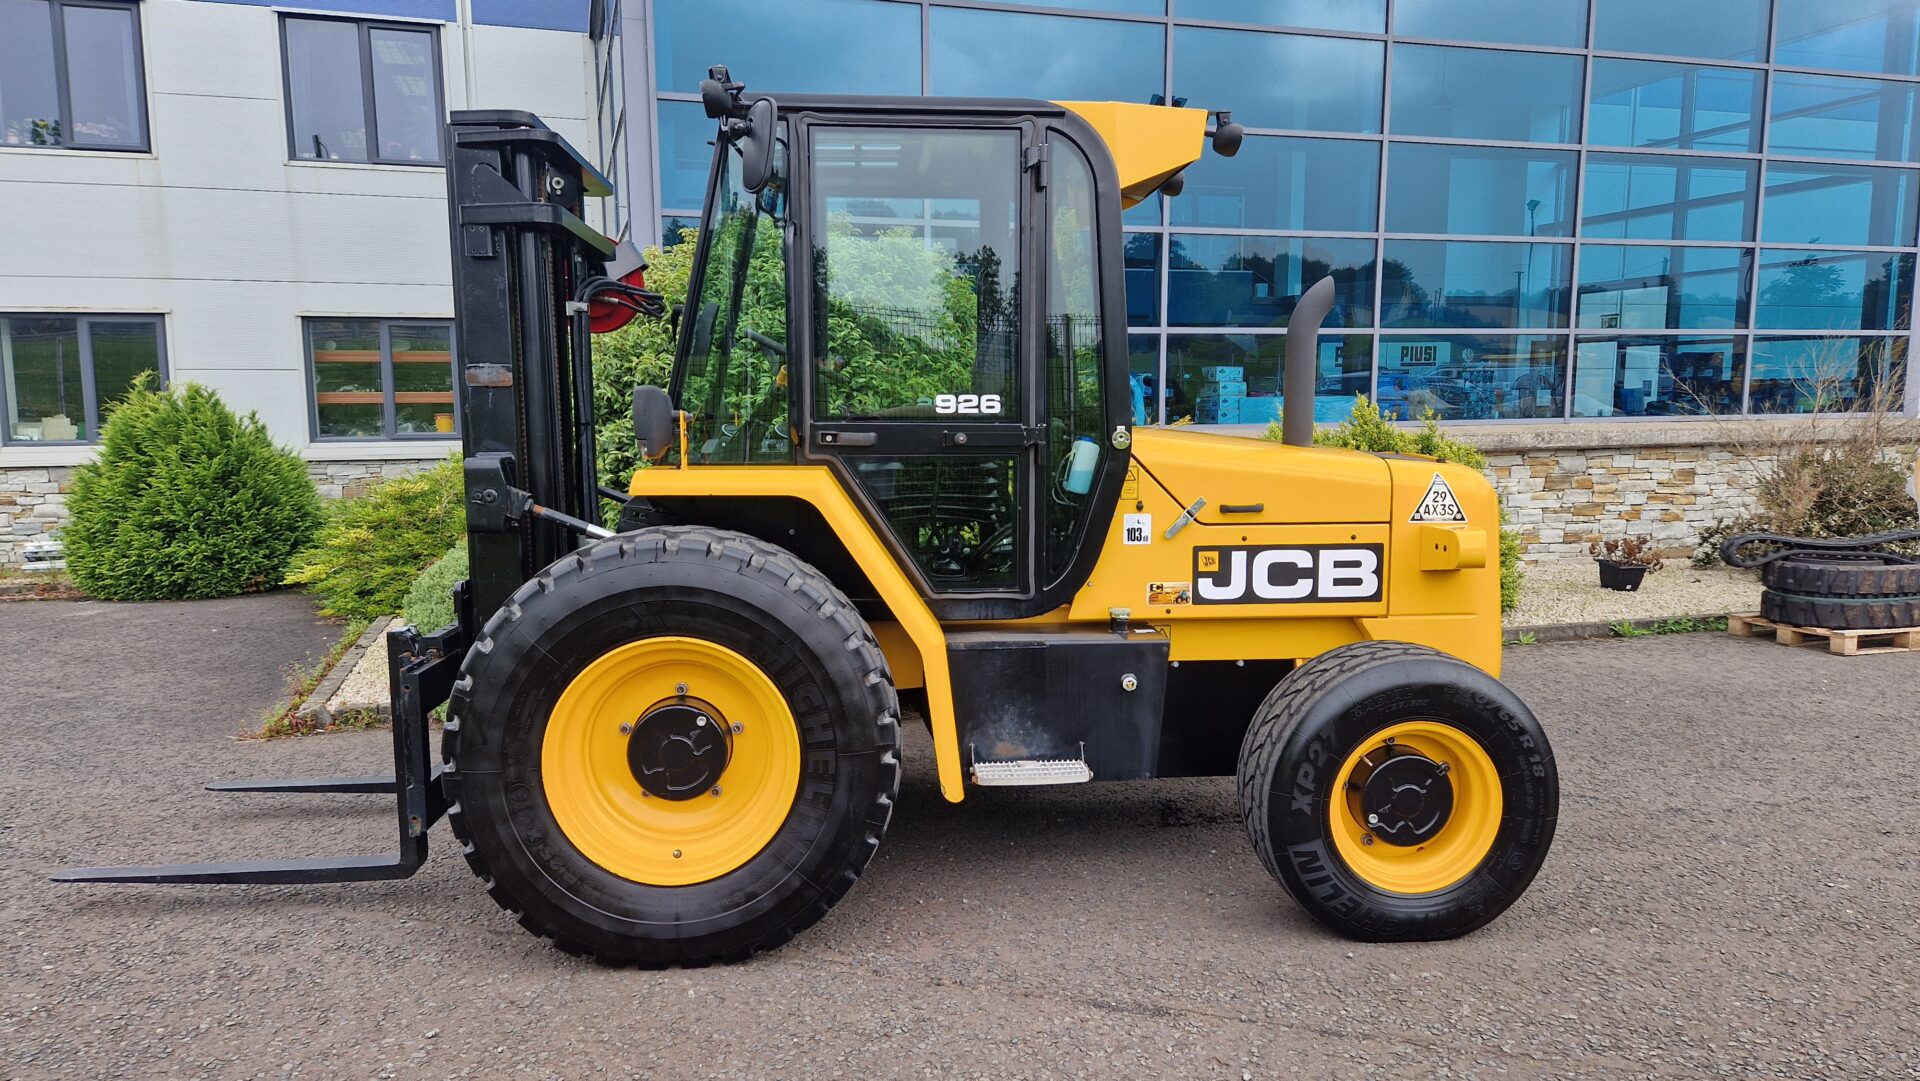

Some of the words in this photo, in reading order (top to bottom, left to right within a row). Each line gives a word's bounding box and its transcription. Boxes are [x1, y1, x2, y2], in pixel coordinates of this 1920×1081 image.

[1400, 345, 1437, 361] PIUSI
[935, 394, 1001, 413] 926
[1432, 491, 1447, 503] 29
[1424, 504, 1454, 516] AX3S
[1126, 527, 1142, 542] 103
[1198, 549, 1378, 600] JCB
[750, 629, 836, 857] MICHELIN
[1518, 735, 1534, 750] R
[1528, 753, 1545, 778] 18
[1290, 719, 1337, 816] XP27
